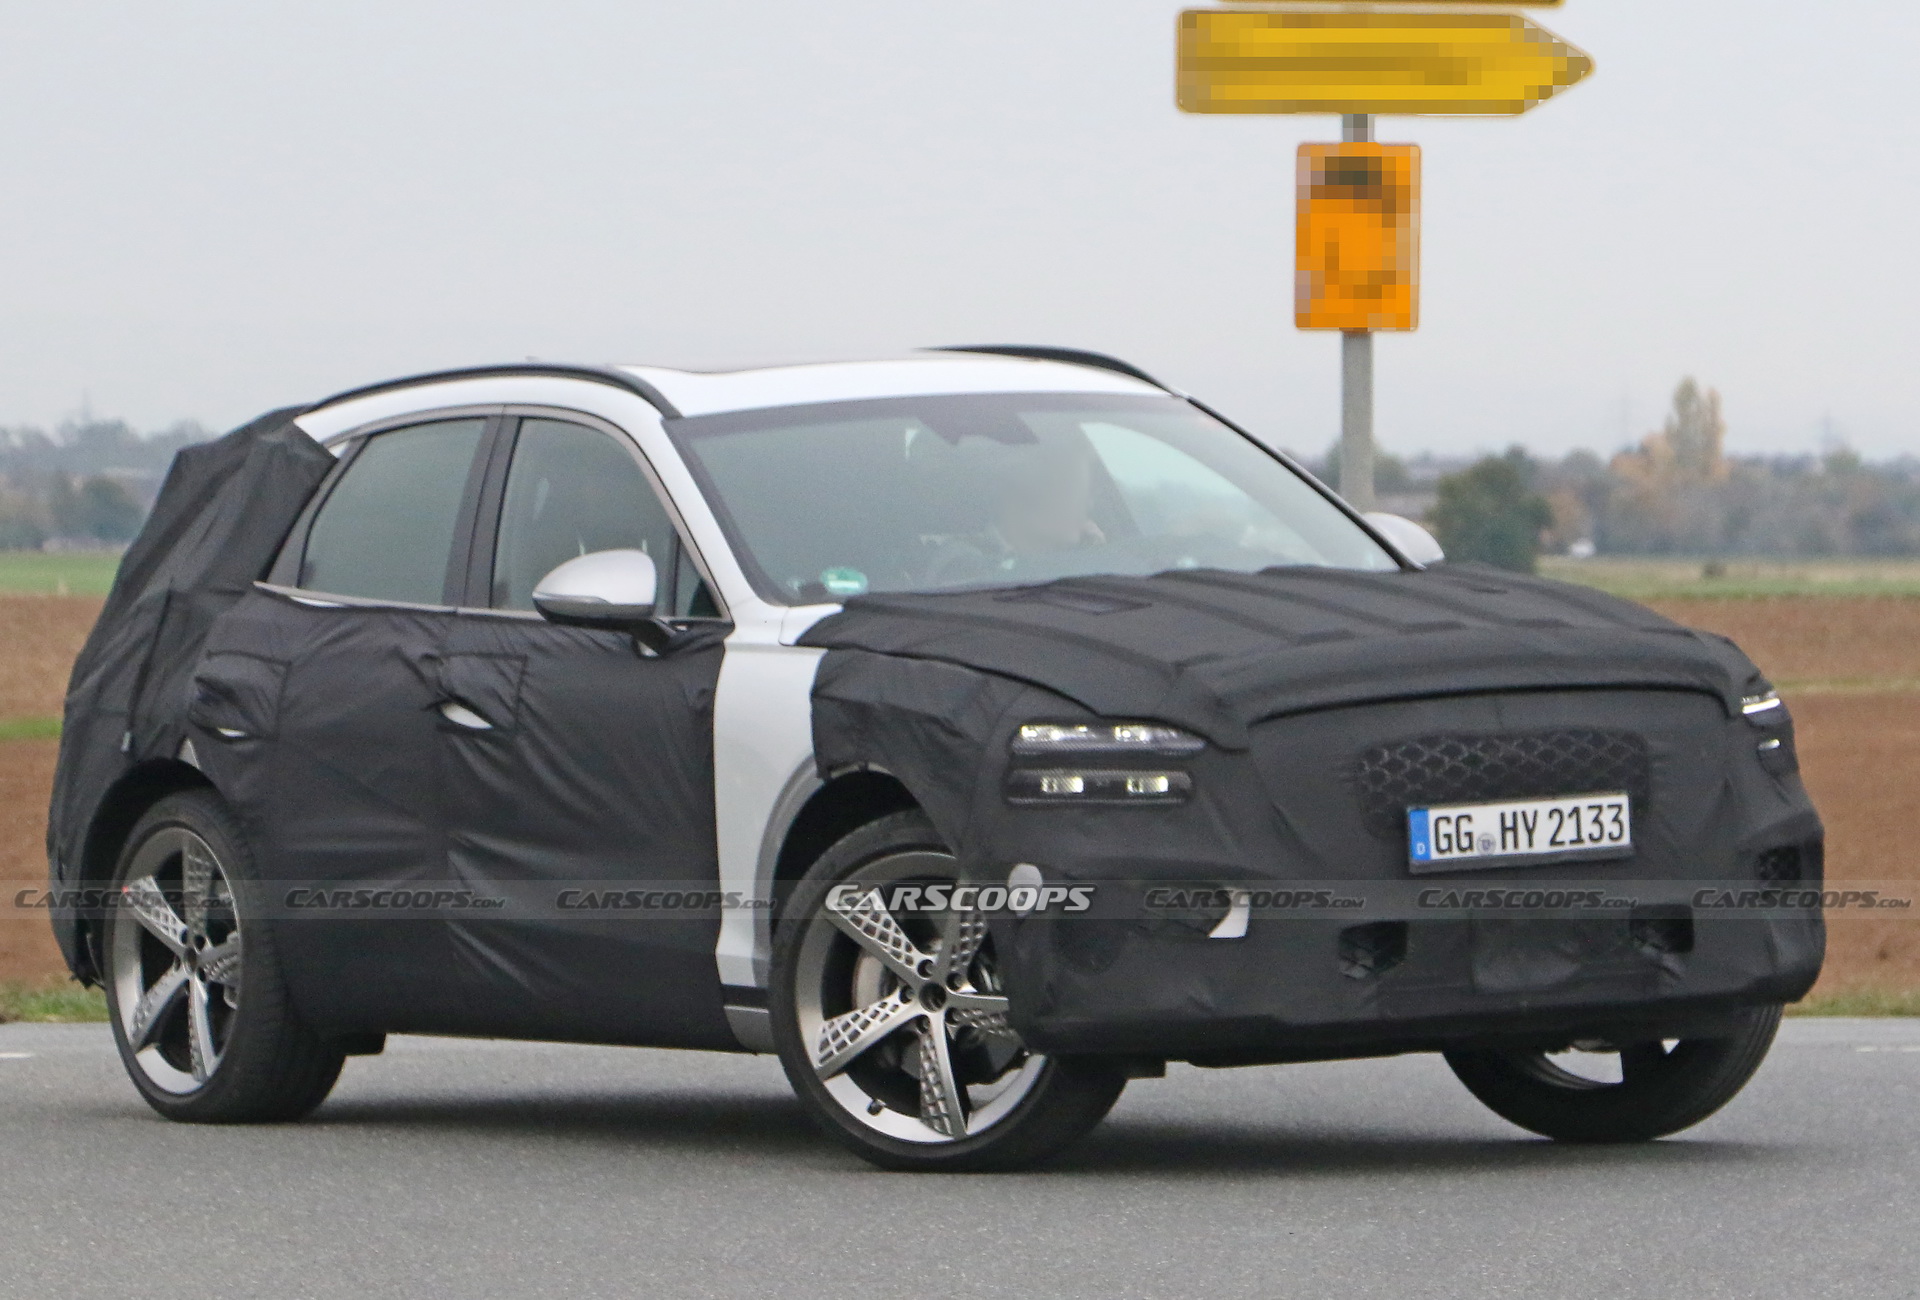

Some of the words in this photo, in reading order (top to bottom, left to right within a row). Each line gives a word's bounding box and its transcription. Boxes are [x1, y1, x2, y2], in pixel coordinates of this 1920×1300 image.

[1434, 814, 1474, 855] GG
[1500, 809, 1538, 850] HY
[1548, 804, 1624, 847] 2133
[1416, 842, 1426, 856] D
